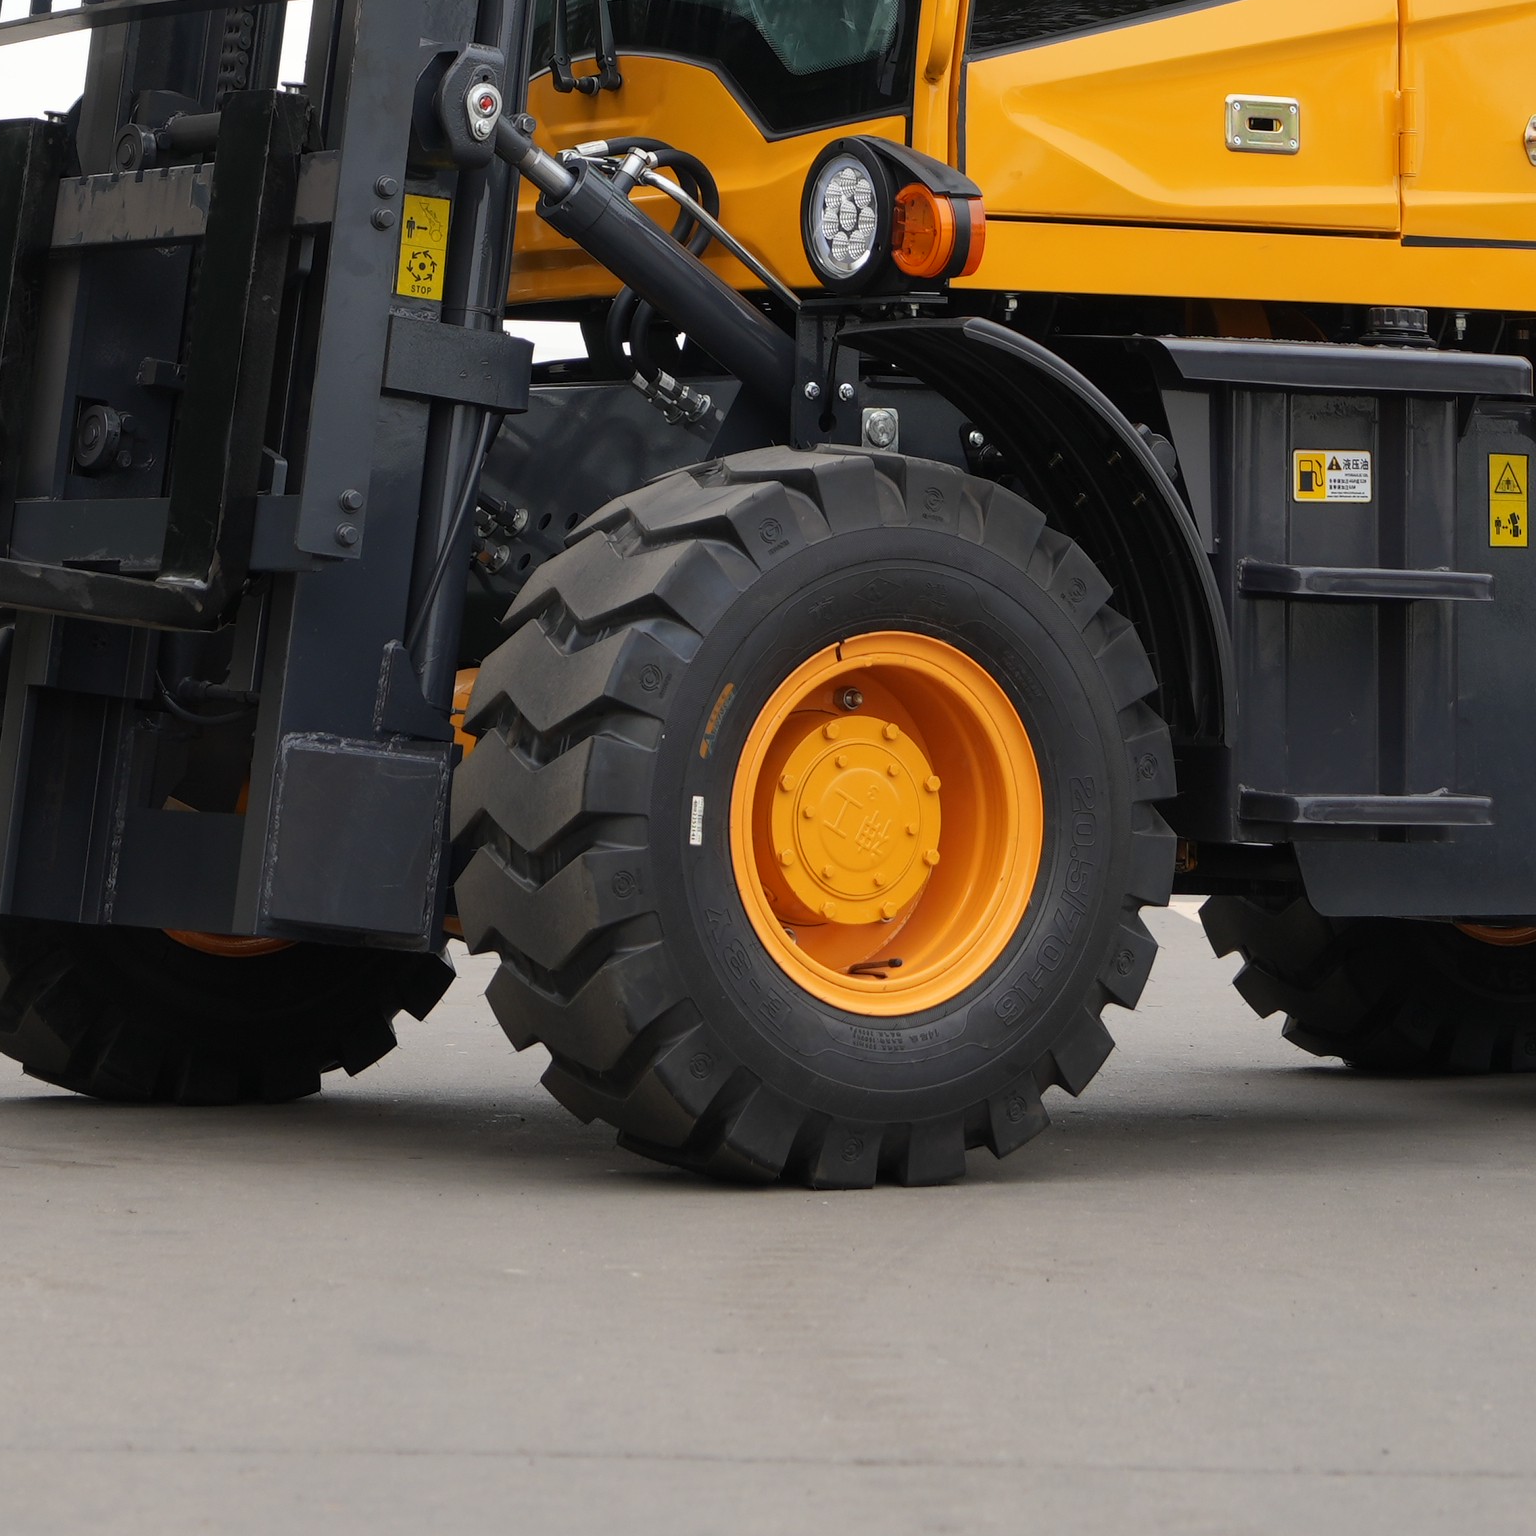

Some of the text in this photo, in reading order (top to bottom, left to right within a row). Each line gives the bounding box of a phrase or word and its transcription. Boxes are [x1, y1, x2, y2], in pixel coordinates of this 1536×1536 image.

[411, 284, 432, 295] STOP
[1343, 458, 1369, 470] 液压油
[995, 776, 1096, 1025] 20.5/70-16
